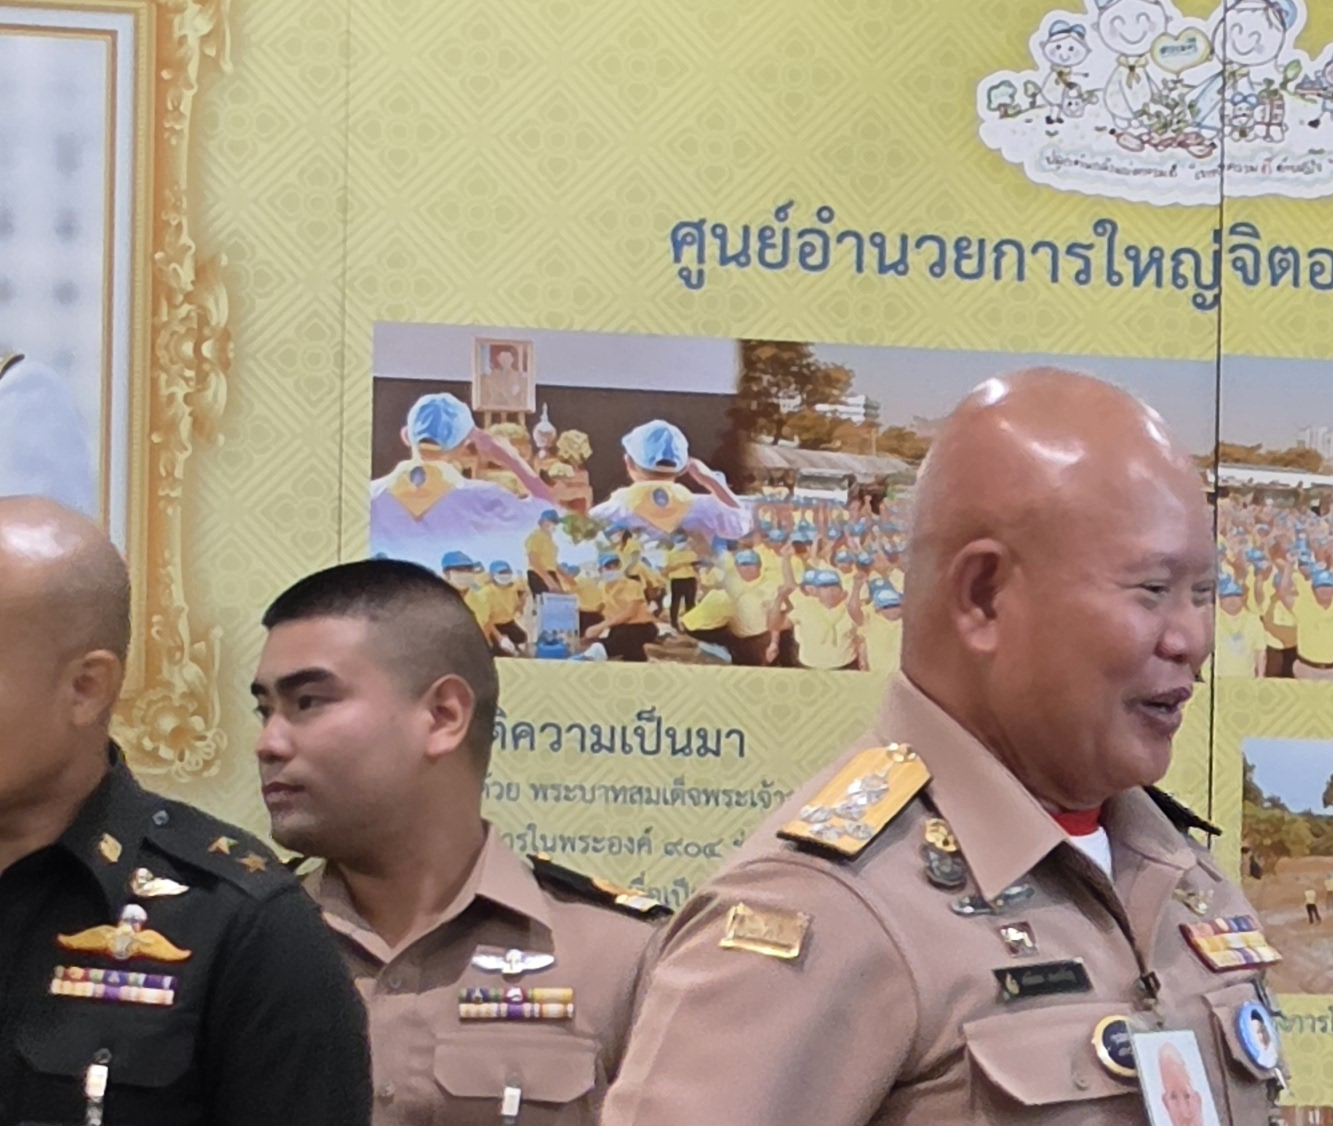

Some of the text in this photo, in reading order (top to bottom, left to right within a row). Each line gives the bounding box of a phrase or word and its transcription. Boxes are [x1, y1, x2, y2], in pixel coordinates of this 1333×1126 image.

[530, 777, 794, 810] พระบาทสมเด็จพระเจ้า
